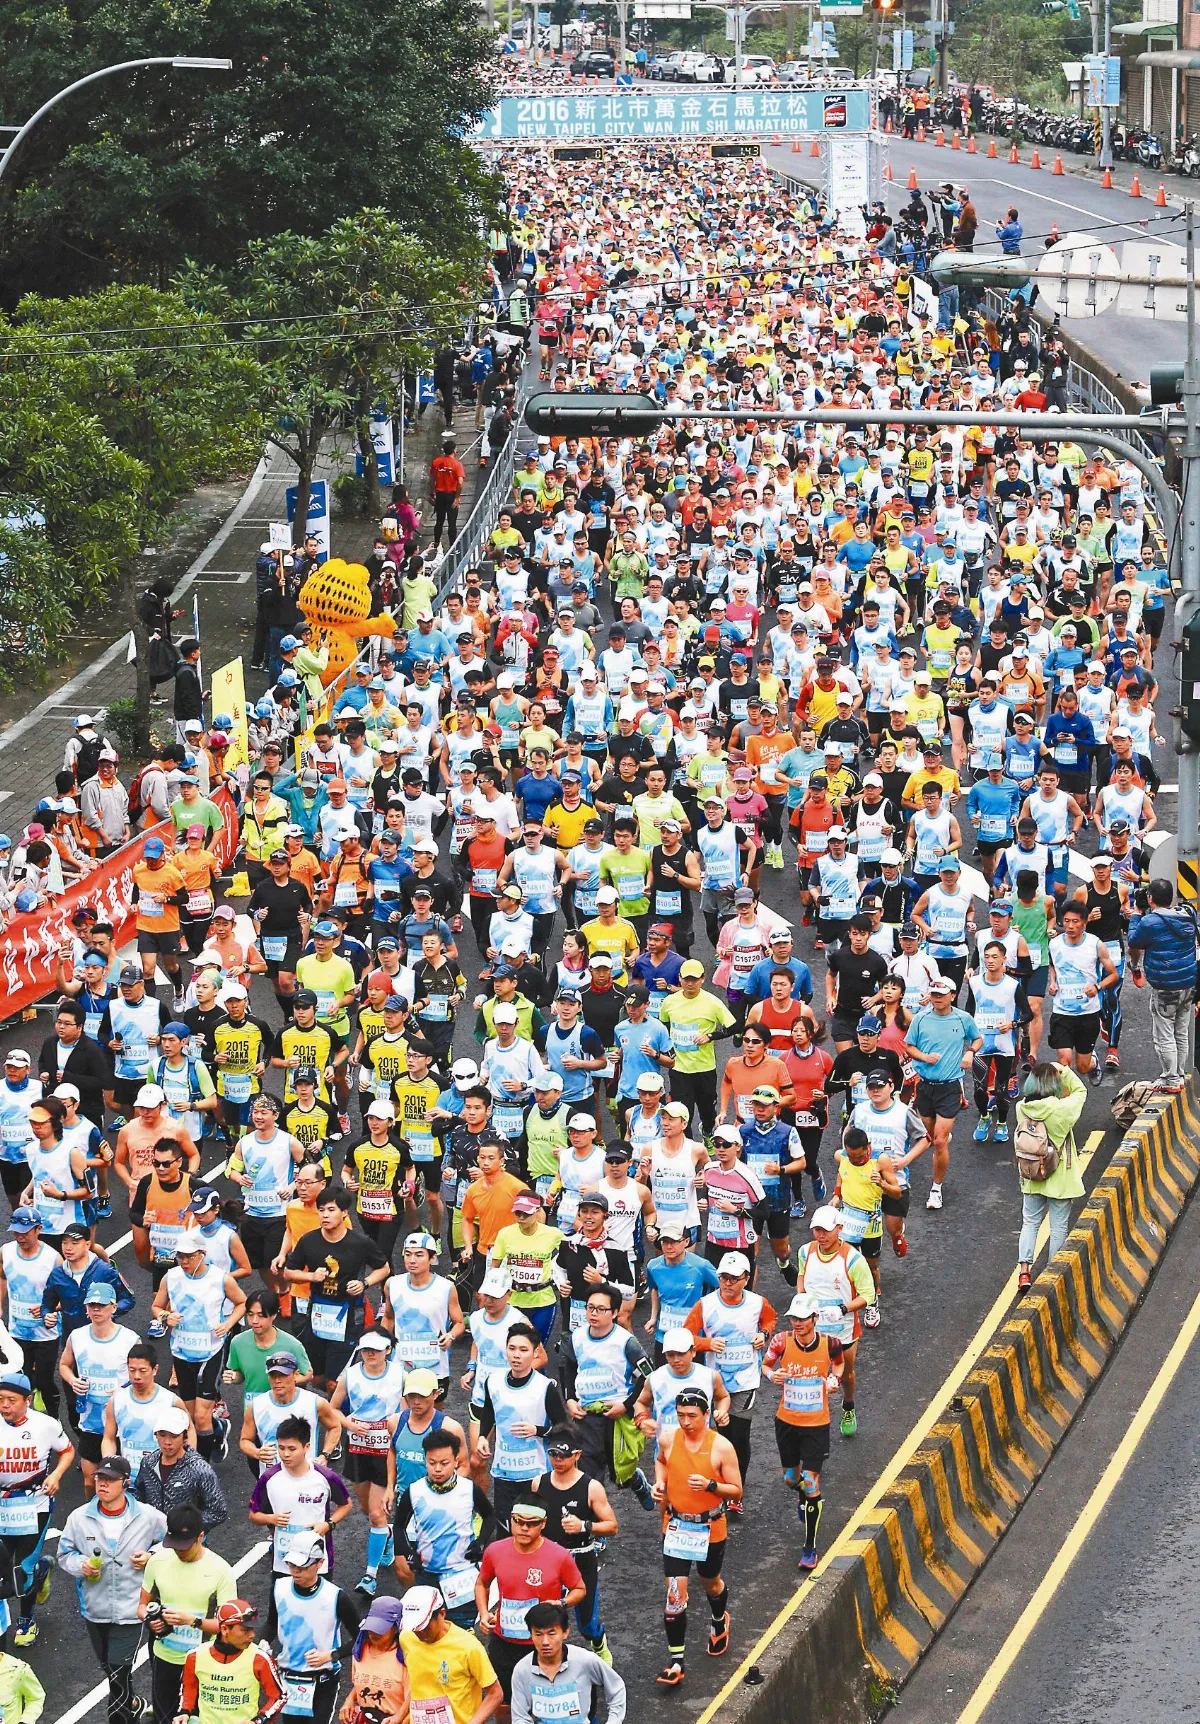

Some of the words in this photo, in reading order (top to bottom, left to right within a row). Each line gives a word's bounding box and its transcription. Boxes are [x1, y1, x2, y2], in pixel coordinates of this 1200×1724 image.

[517, 100, 569, 121] 2016
[575, 96, 809, 120] 新北市萬金石馬拉松
[517, 123, 547, 136] NEW
[553, 122, 596, 135] TAIPEI
[605, 122, 635, 134] CITY
[643, 121, 673, 133] WAN
[679, 121, 700, 132] JIN
[706, 120, 728, 132] SHI
[735, 119, 808, 131] MARATHON
[735, 954, 761, 963] C15720
[226, 1040, 249, 1051] 2015
[293, 1045, 317, 1056] 2015
[378, 1057, 399, 1068] 2015
[404, 1095, 427, 1106] 2015
[796, 1115, 817, 1124] C154
[295, 1124, 319, 1135] 2015
[363, 1159, 389, 1171] 2015
[362, 1201, 392, 1210] B15317
[510, 1269, 541, 1280] C15047
[402, 1346, 438, 1356] B14424
[785, 1389, 821, 1400] C10153
[351, 1433, 389, 1445] C15635
[6, 1446, 38, 1459] LOVE
[500, 1455, 536, 1467] C11637
[0, 1511, 35, 1522] B14064
[534, 1700, 577, 1713] C10784
